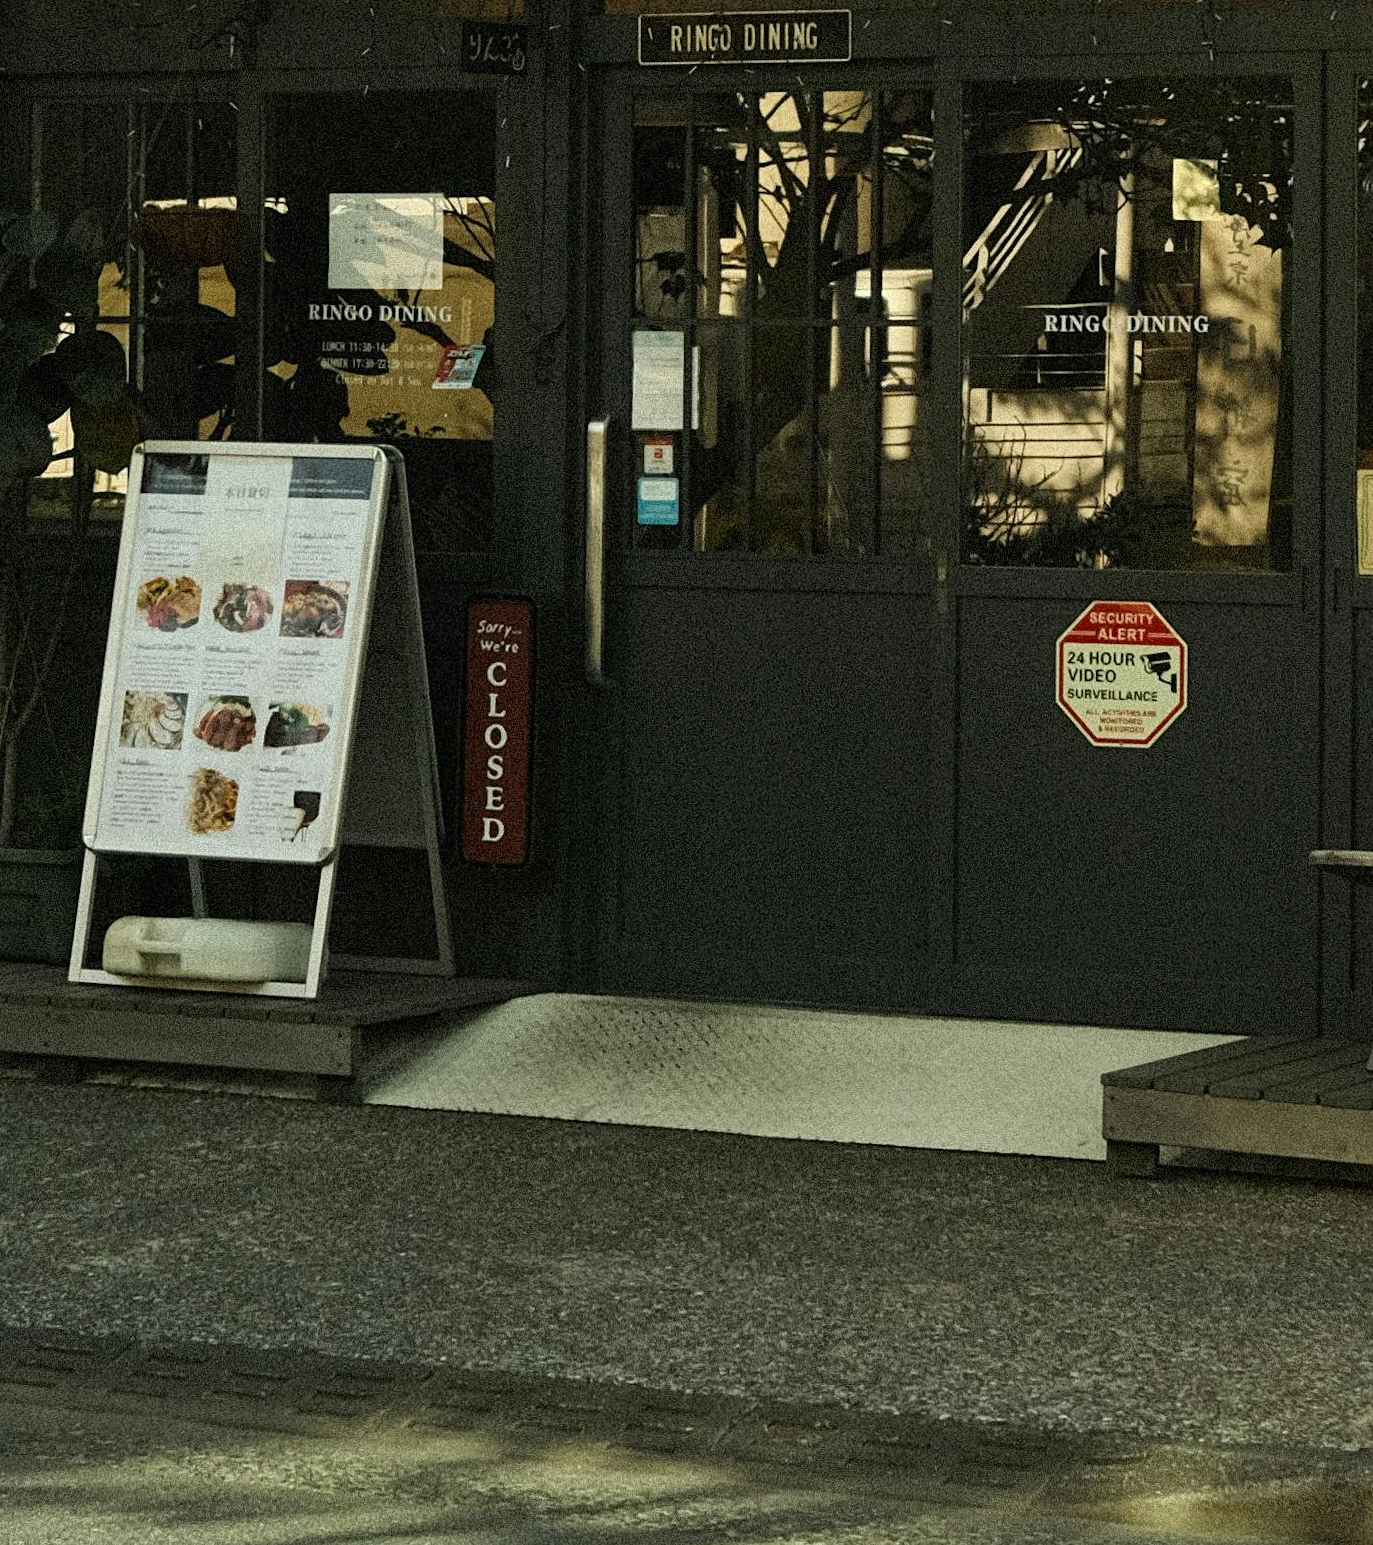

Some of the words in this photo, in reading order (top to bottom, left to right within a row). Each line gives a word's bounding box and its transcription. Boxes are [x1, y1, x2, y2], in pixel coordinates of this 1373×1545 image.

[670, 23, 732, 53] RINGO
[743, 21, 819, 52] DINING
[307, 303, 373, 321] RINGO
[379, 304, 453, 323] DINING
[1126, 314, 1210, 334] DINING
[1089, 612, 1155, 625] SECURITY
[1097, 627, 1147, 642] ALERT
[480, 639, 520, 654] We're
[1067, 651, 1085, 665] 24
[1089, 651, 1136, 667] HOUR
[1067, 668, 1117, 684] VIDEO
[1067, 687, 1159, 702] SURVEILLANCE
[481, 662, 508, 842] CLOSED
